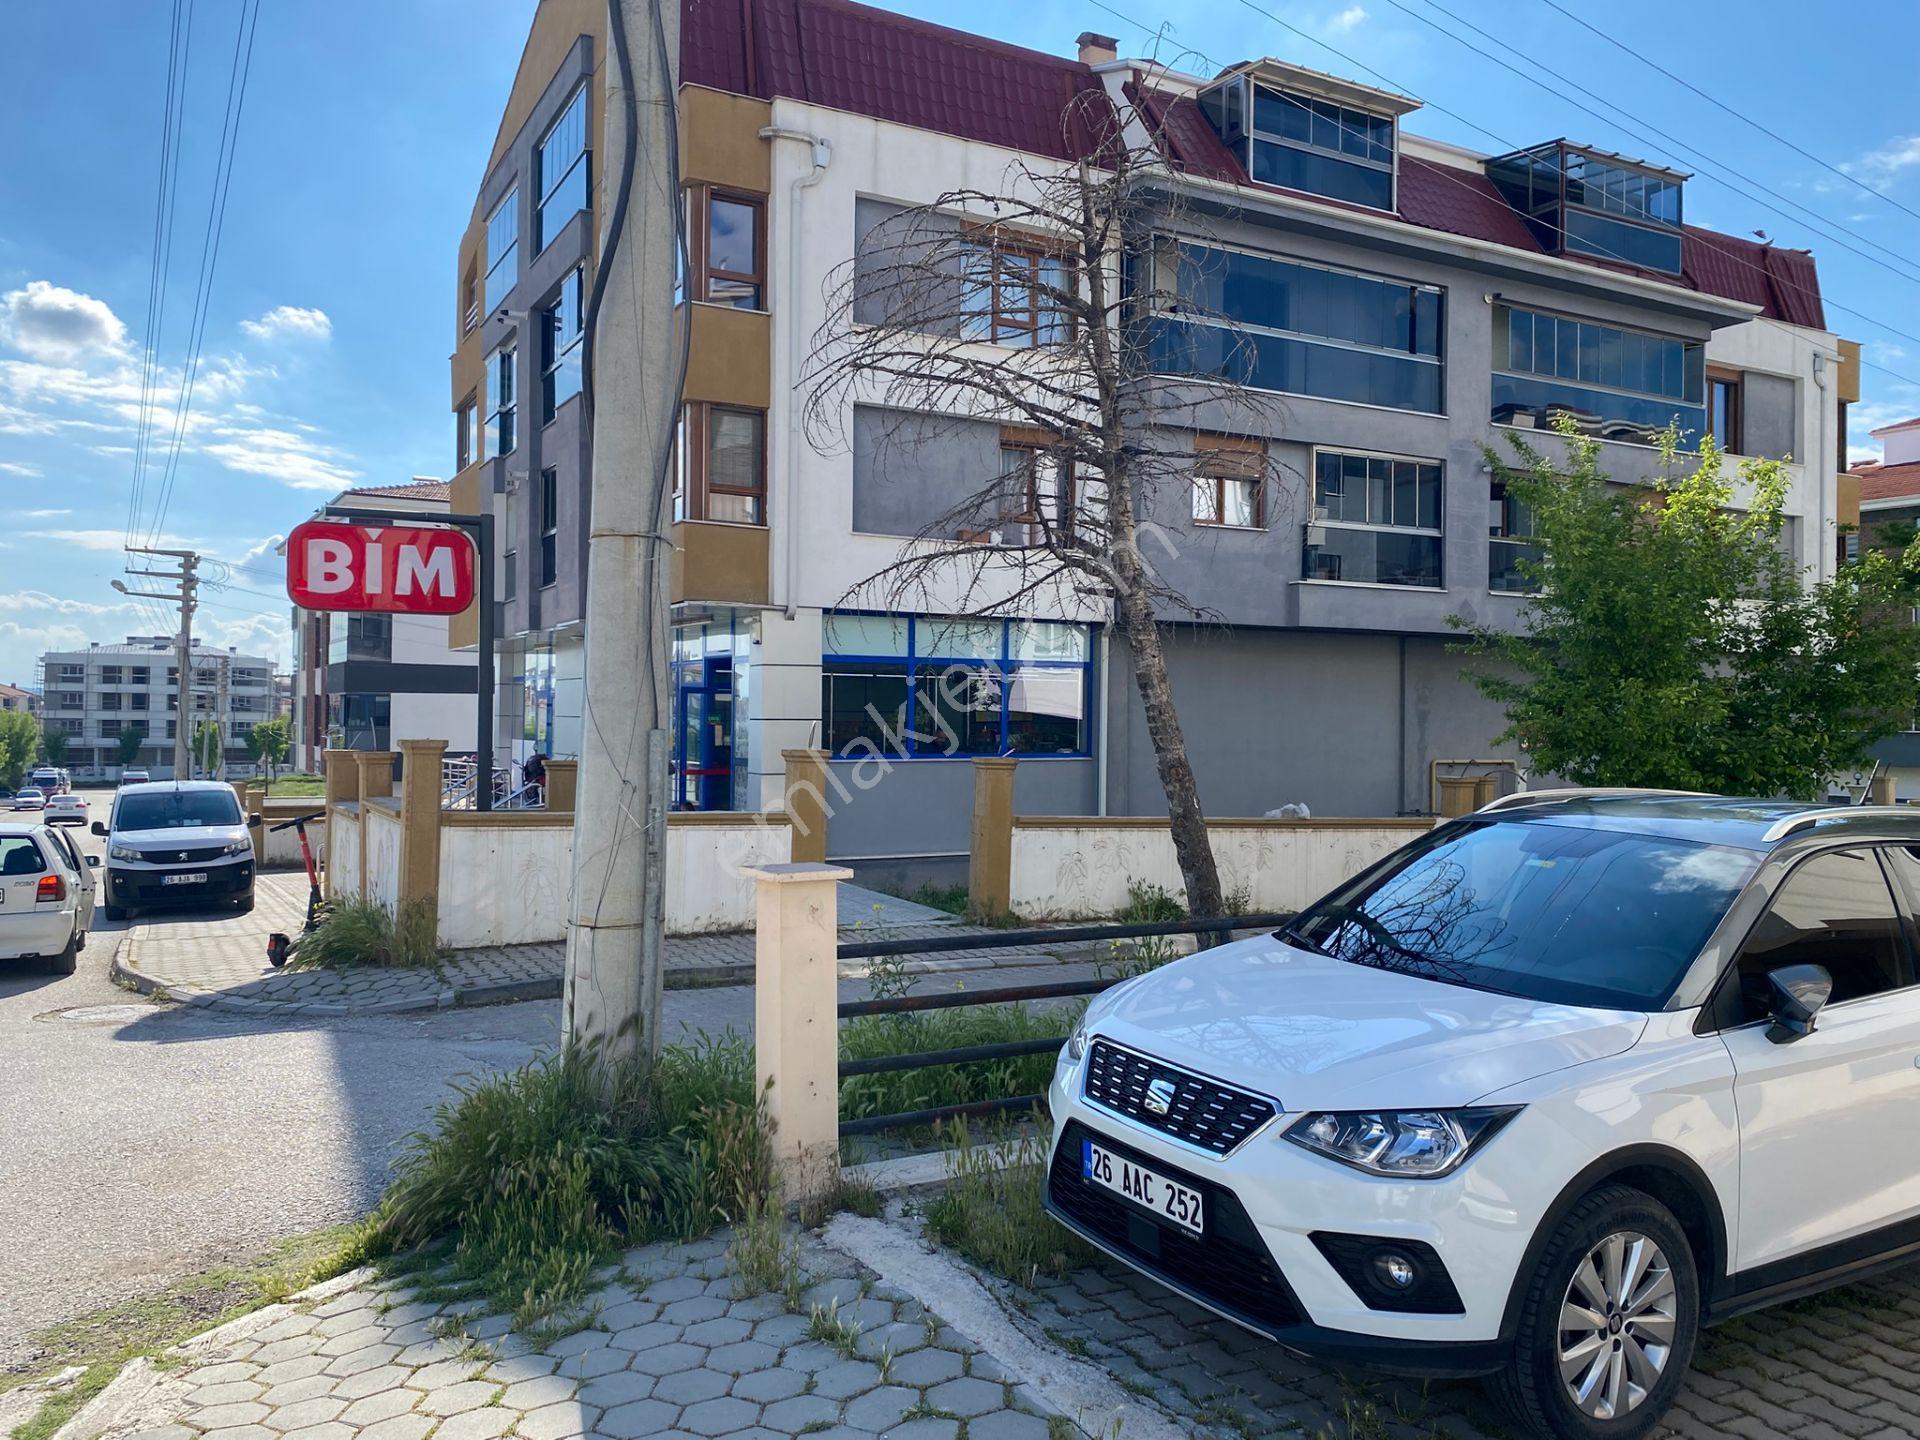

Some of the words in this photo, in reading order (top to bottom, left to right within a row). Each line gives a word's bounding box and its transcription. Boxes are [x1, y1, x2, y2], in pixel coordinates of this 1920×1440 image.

[307, 528, 456, 598] BİM
[1093, 1148, 1112, 1183] 26
[1123, 1163, 1154, 1204] AAC
[1165, 1183, 1201, 1229] 252
